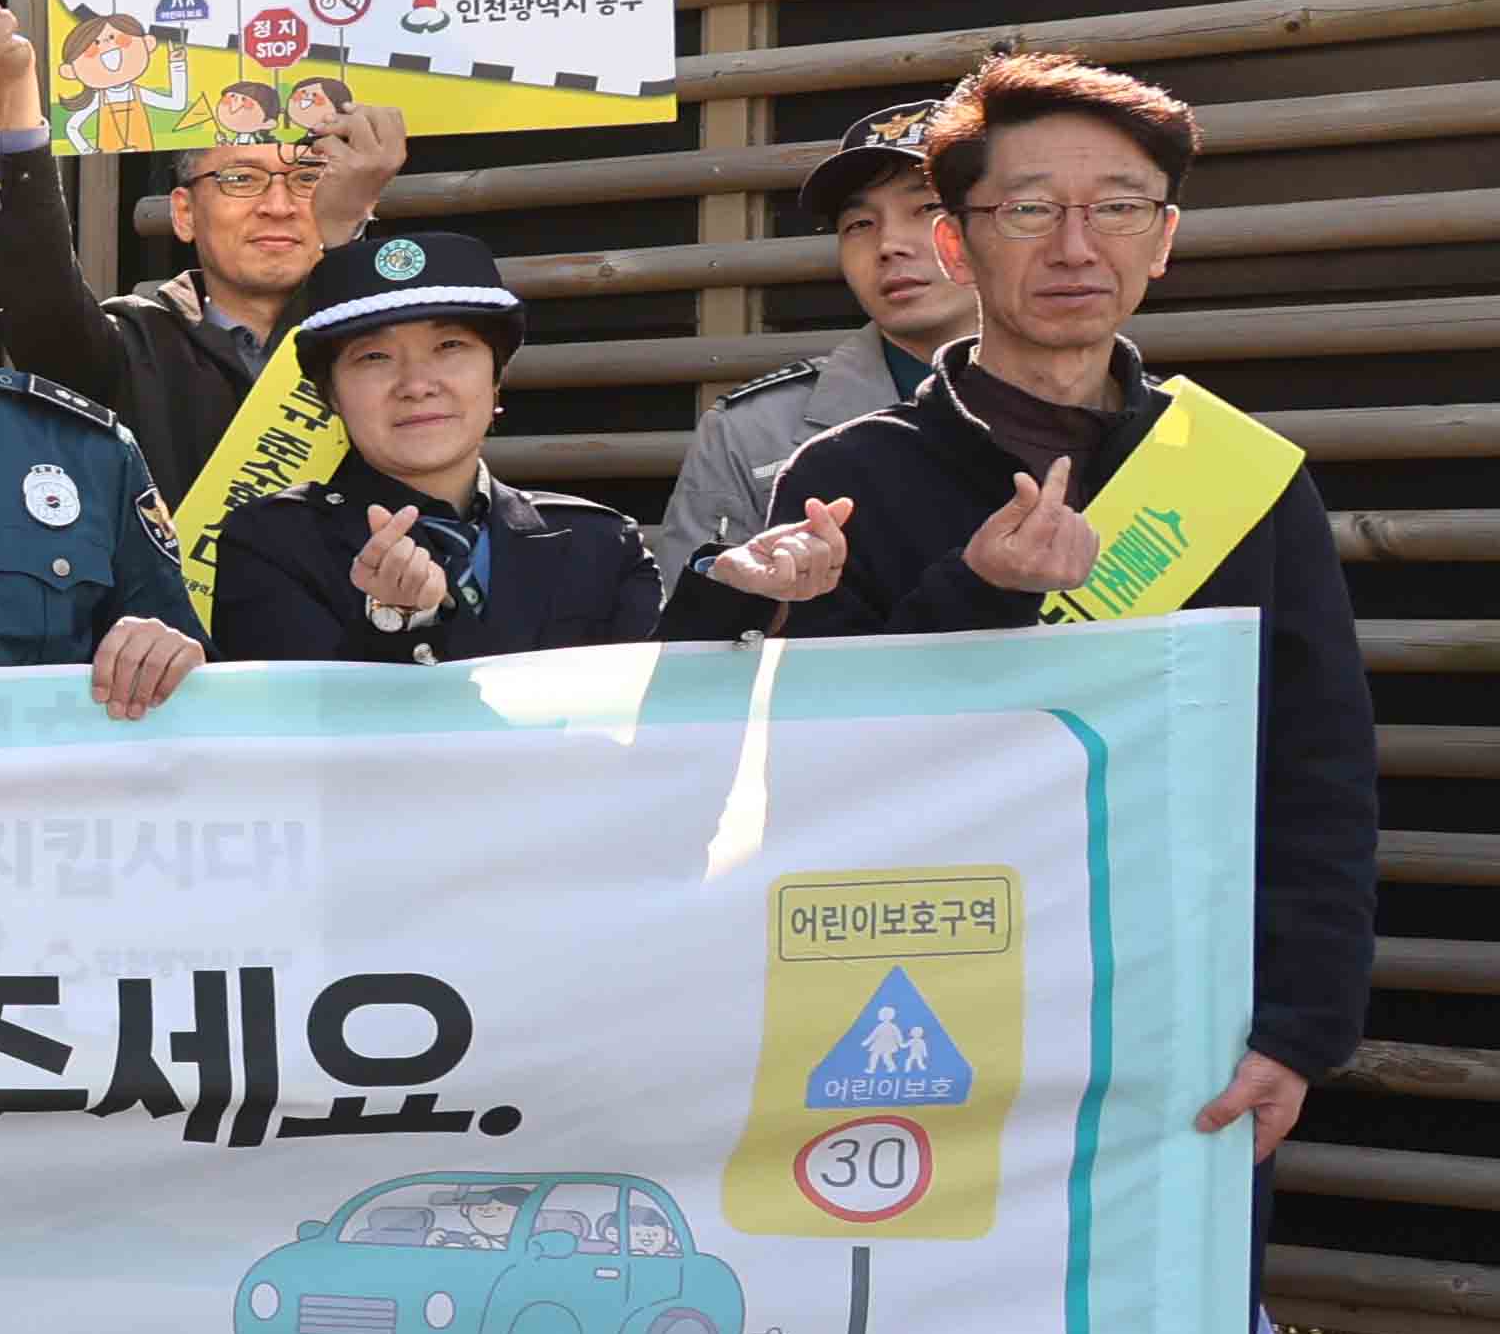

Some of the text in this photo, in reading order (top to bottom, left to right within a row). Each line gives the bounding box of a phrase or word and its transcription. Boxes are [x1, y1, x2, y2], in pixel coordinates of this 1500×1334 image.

[256, 41, 297, 58] STOP
[1084, 506, 1190, 617] 스쿨존
[790, 897, 997, 943] 어린이보호구역
[825, 1076, 955, 1103] 어린이보호
[820, 1136, 906, 1189] 30
